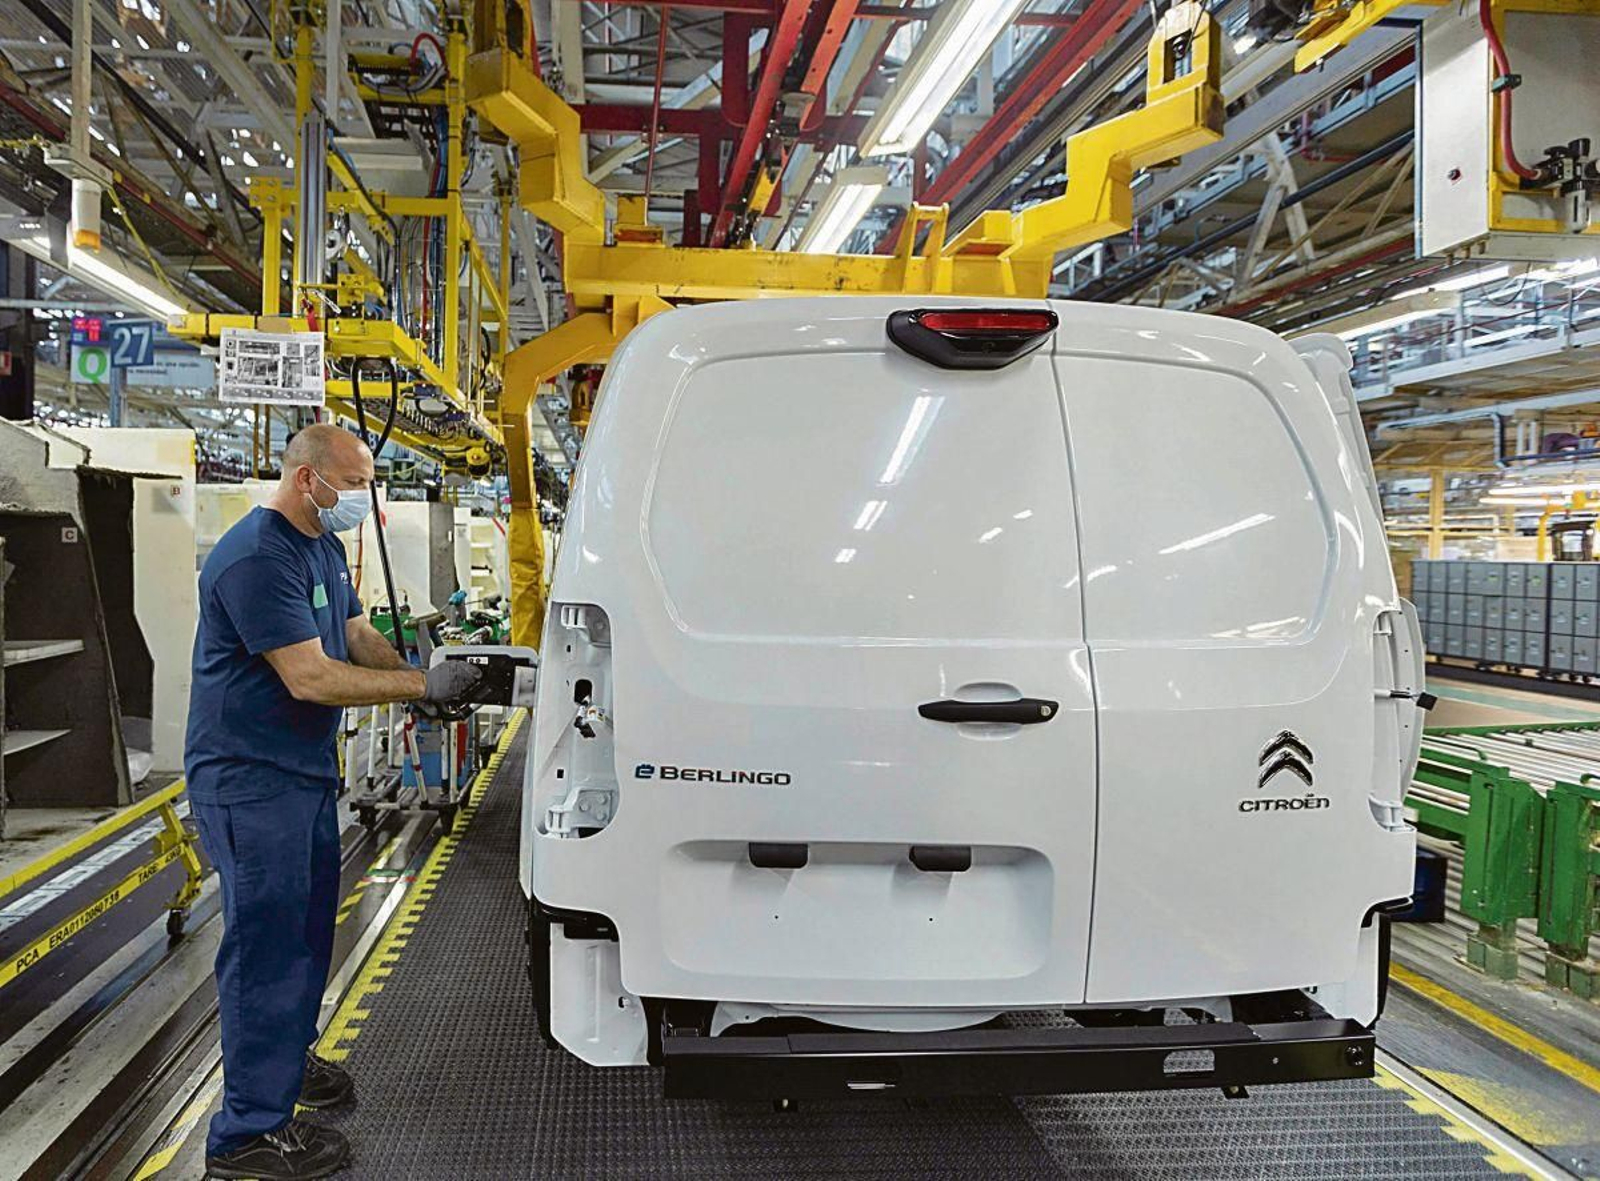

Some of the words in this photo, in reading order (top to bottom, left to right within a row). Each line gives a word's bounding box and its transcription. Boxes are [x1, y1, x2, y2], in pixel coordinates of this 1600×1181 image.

[113, 326, 150, 365] 27
[77, 348, 108, 384] Q
[64, 530, 75, 540] C
[660, 766, 791, 786] BERLINGO
[16, 949, 40, 973] PCA
